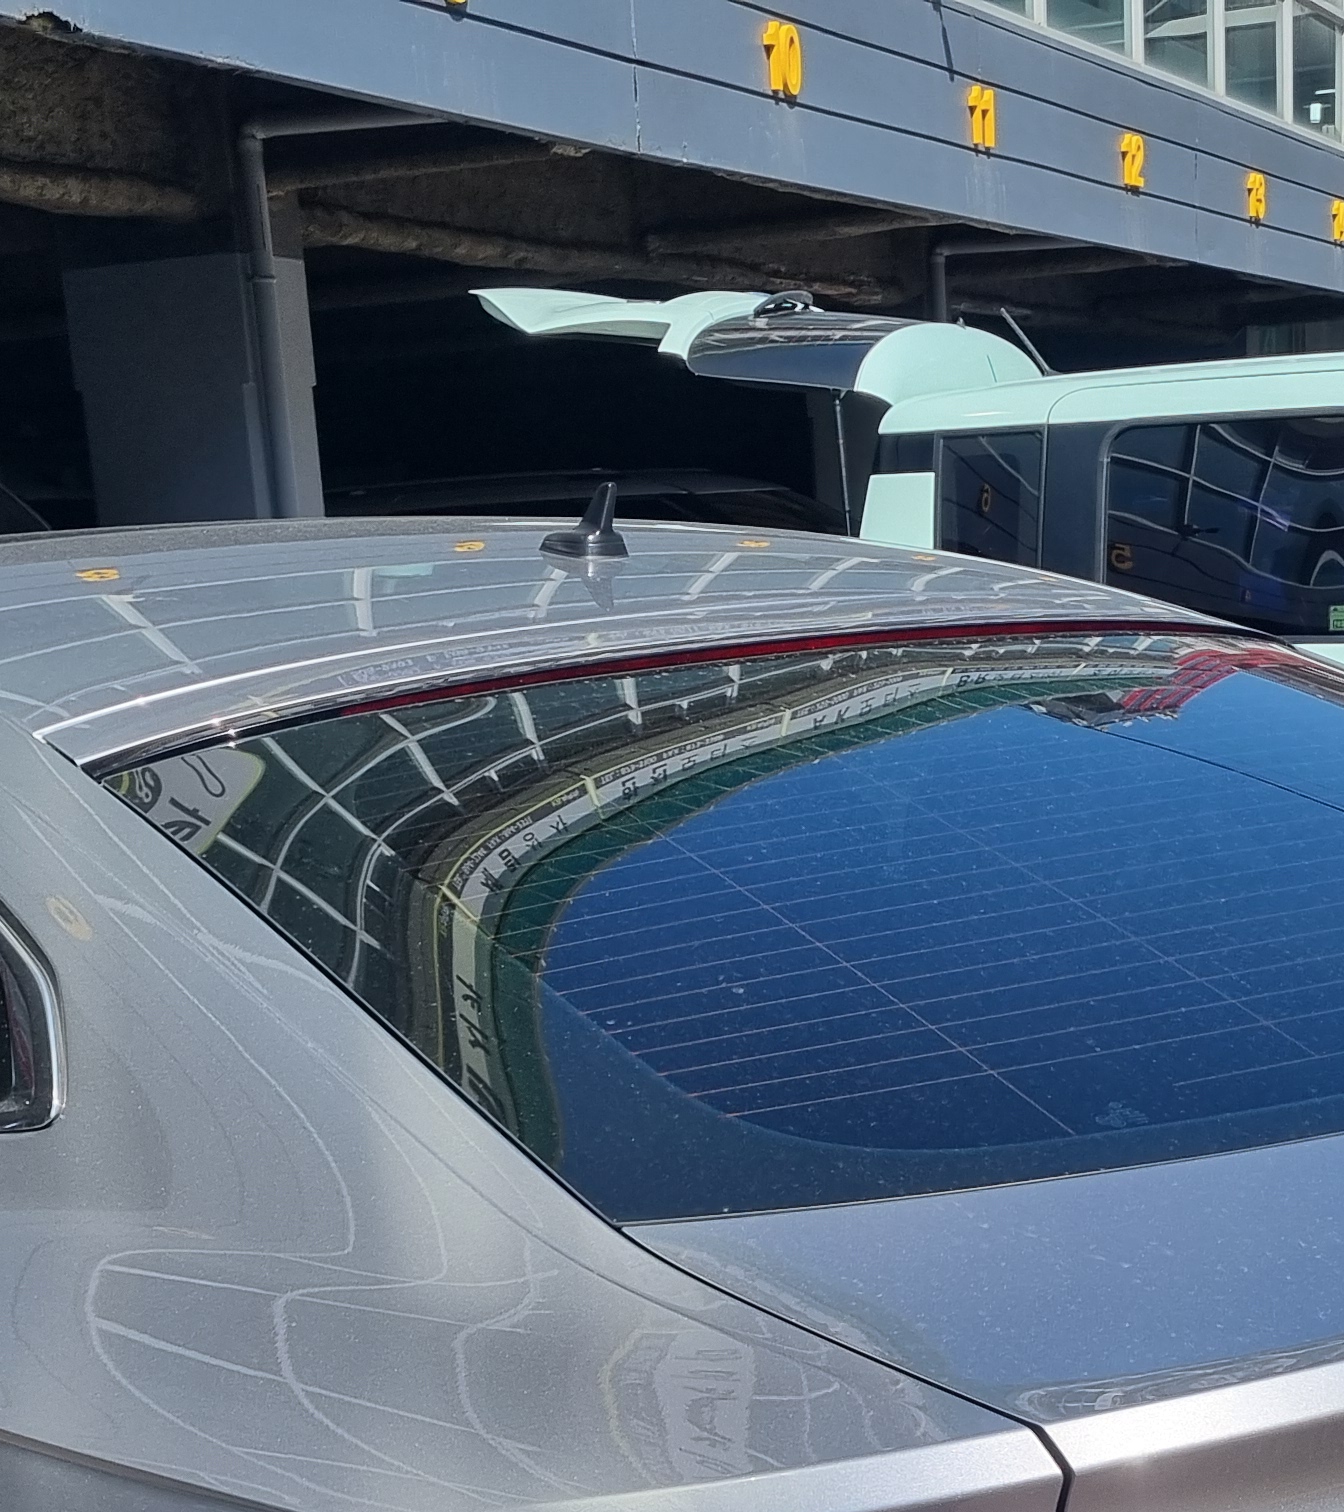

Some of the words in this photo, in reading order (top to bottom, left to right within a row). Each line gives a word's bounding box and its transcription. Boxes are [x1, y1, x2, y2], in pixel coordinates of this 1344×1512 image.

[762, 20, 802, 96] 10
[968, 85, 995, 148] 11
[1121, 133, 1144, 188] 12
[1247, 173, 1265, 219] 13
